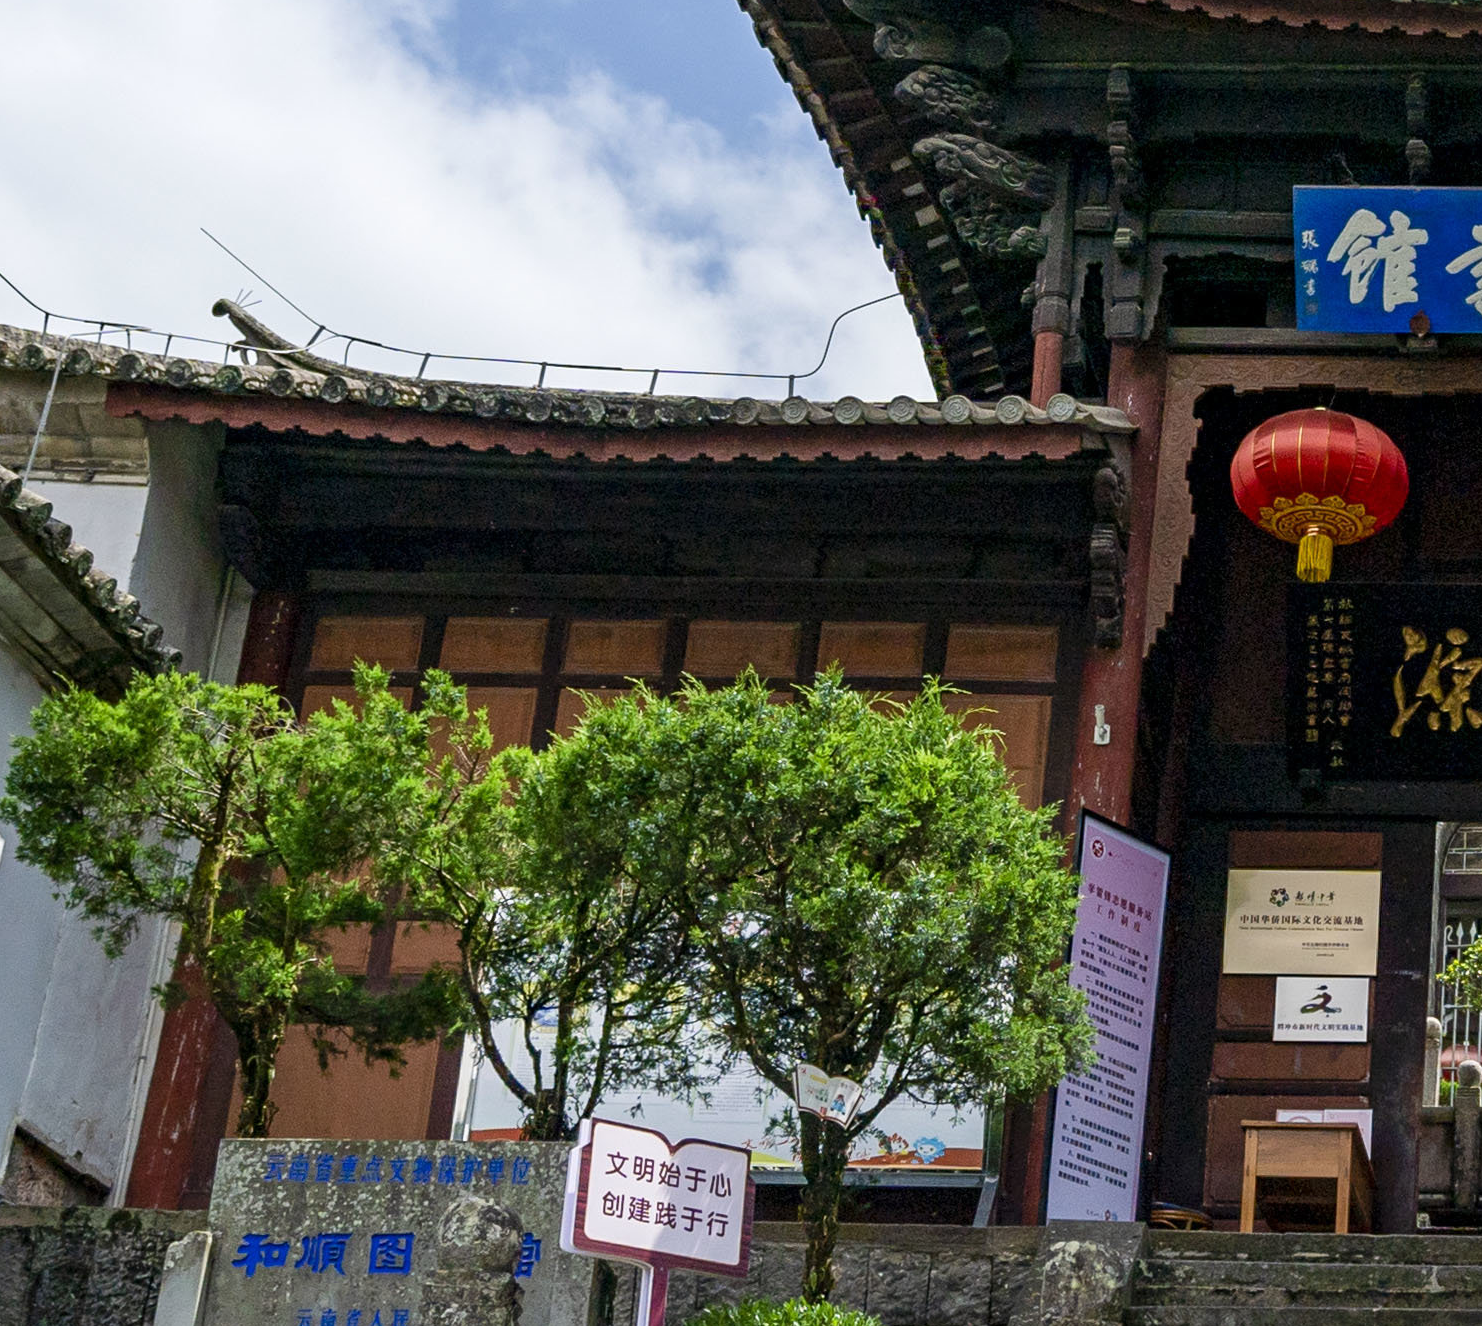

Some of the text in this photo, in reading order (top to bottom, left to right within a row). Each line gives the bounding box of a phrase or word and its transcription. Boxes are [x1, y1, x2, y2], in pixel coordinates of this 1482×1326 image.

[605, 1151, 732, 1198] 文明始于心
[602, 1191, 729, 1237] 创建践于行
